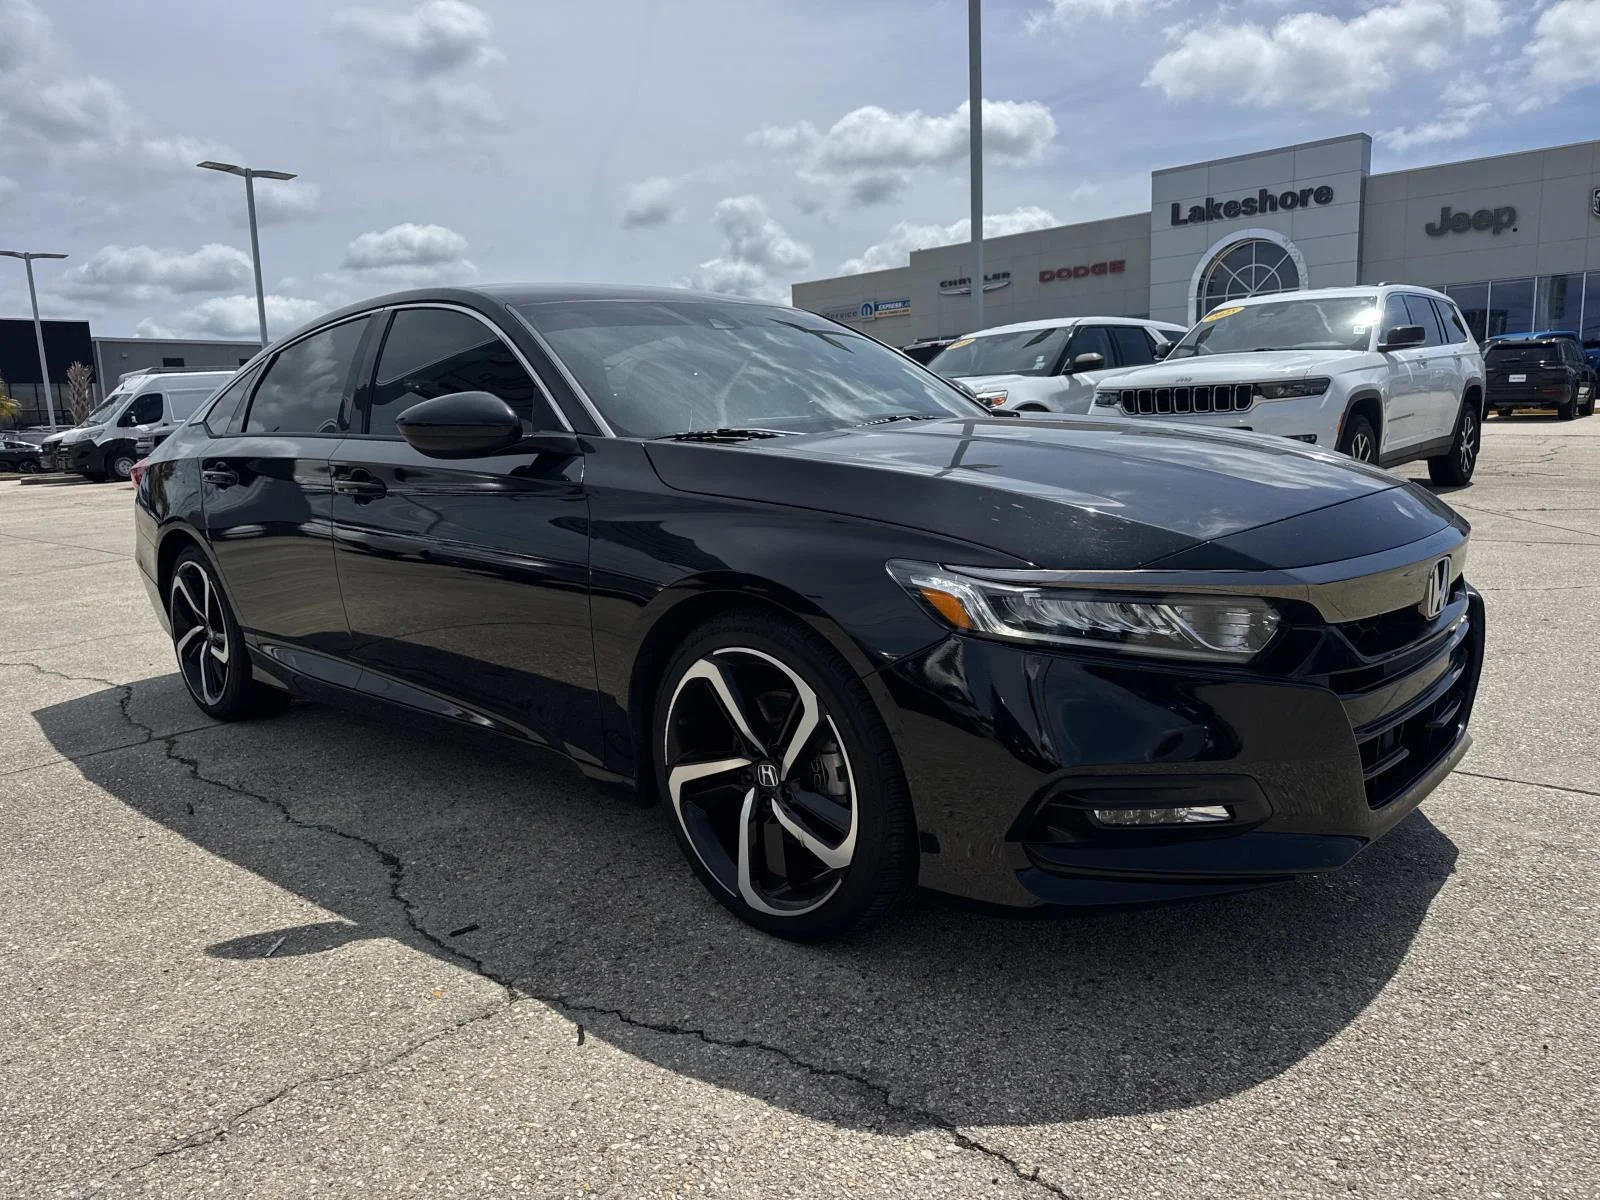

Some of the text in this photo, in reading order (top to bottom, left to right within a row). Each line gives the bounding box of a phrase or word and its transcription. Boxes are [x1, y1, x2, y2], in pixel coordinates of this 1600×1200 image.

[1171, 185, 1333, 226] Lakeshore
[939, 272, 1011, 288] CHRLER
[1038, 259, 1126, 282] DODGE
